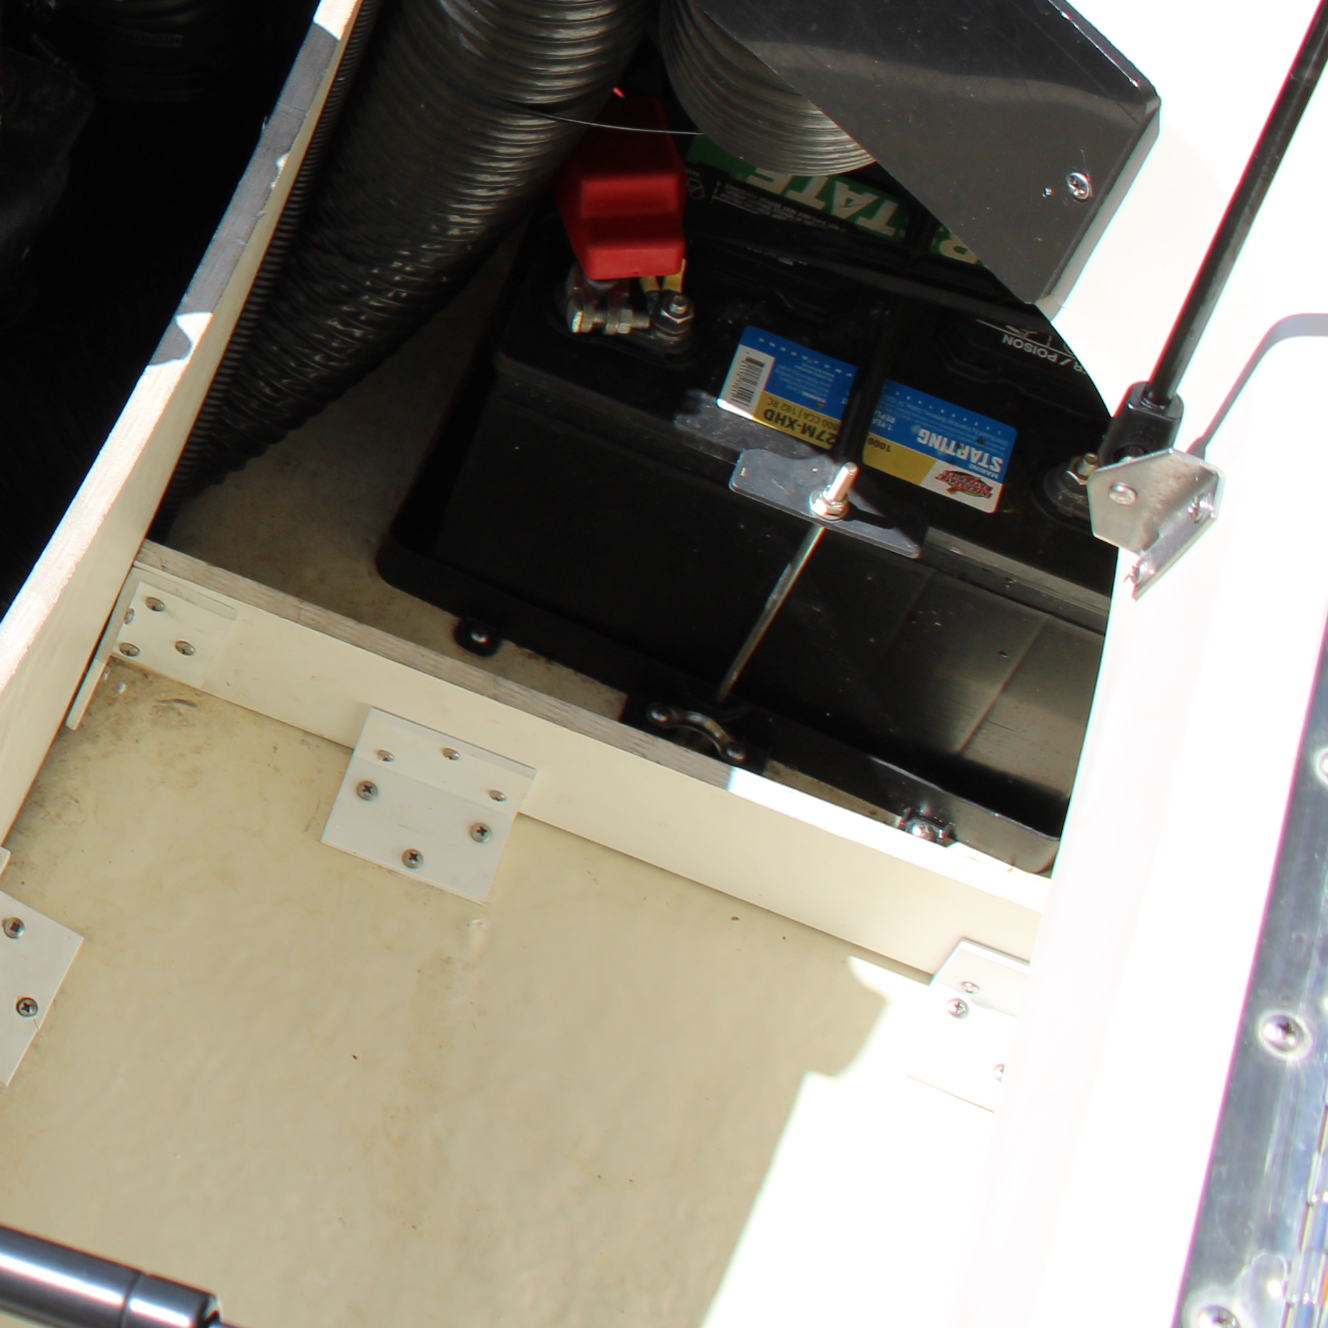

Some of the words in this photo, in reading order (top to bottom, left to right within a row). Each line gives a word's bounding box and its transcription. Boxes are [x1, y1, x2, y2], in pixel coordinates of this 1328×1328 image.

[1001, 334, 1059, 363] POISON
[767, 397, 779, 407] RC
[780, 403, 796, 413] 182
[803, 413, 821, 424] CCA
[762, 408, 839, 447] 27M-XHD
[867, 436, 892, 453] 1000
[916, 428, 1005, 473] STARTING
[968, 463, 1000, 479] MARINE
